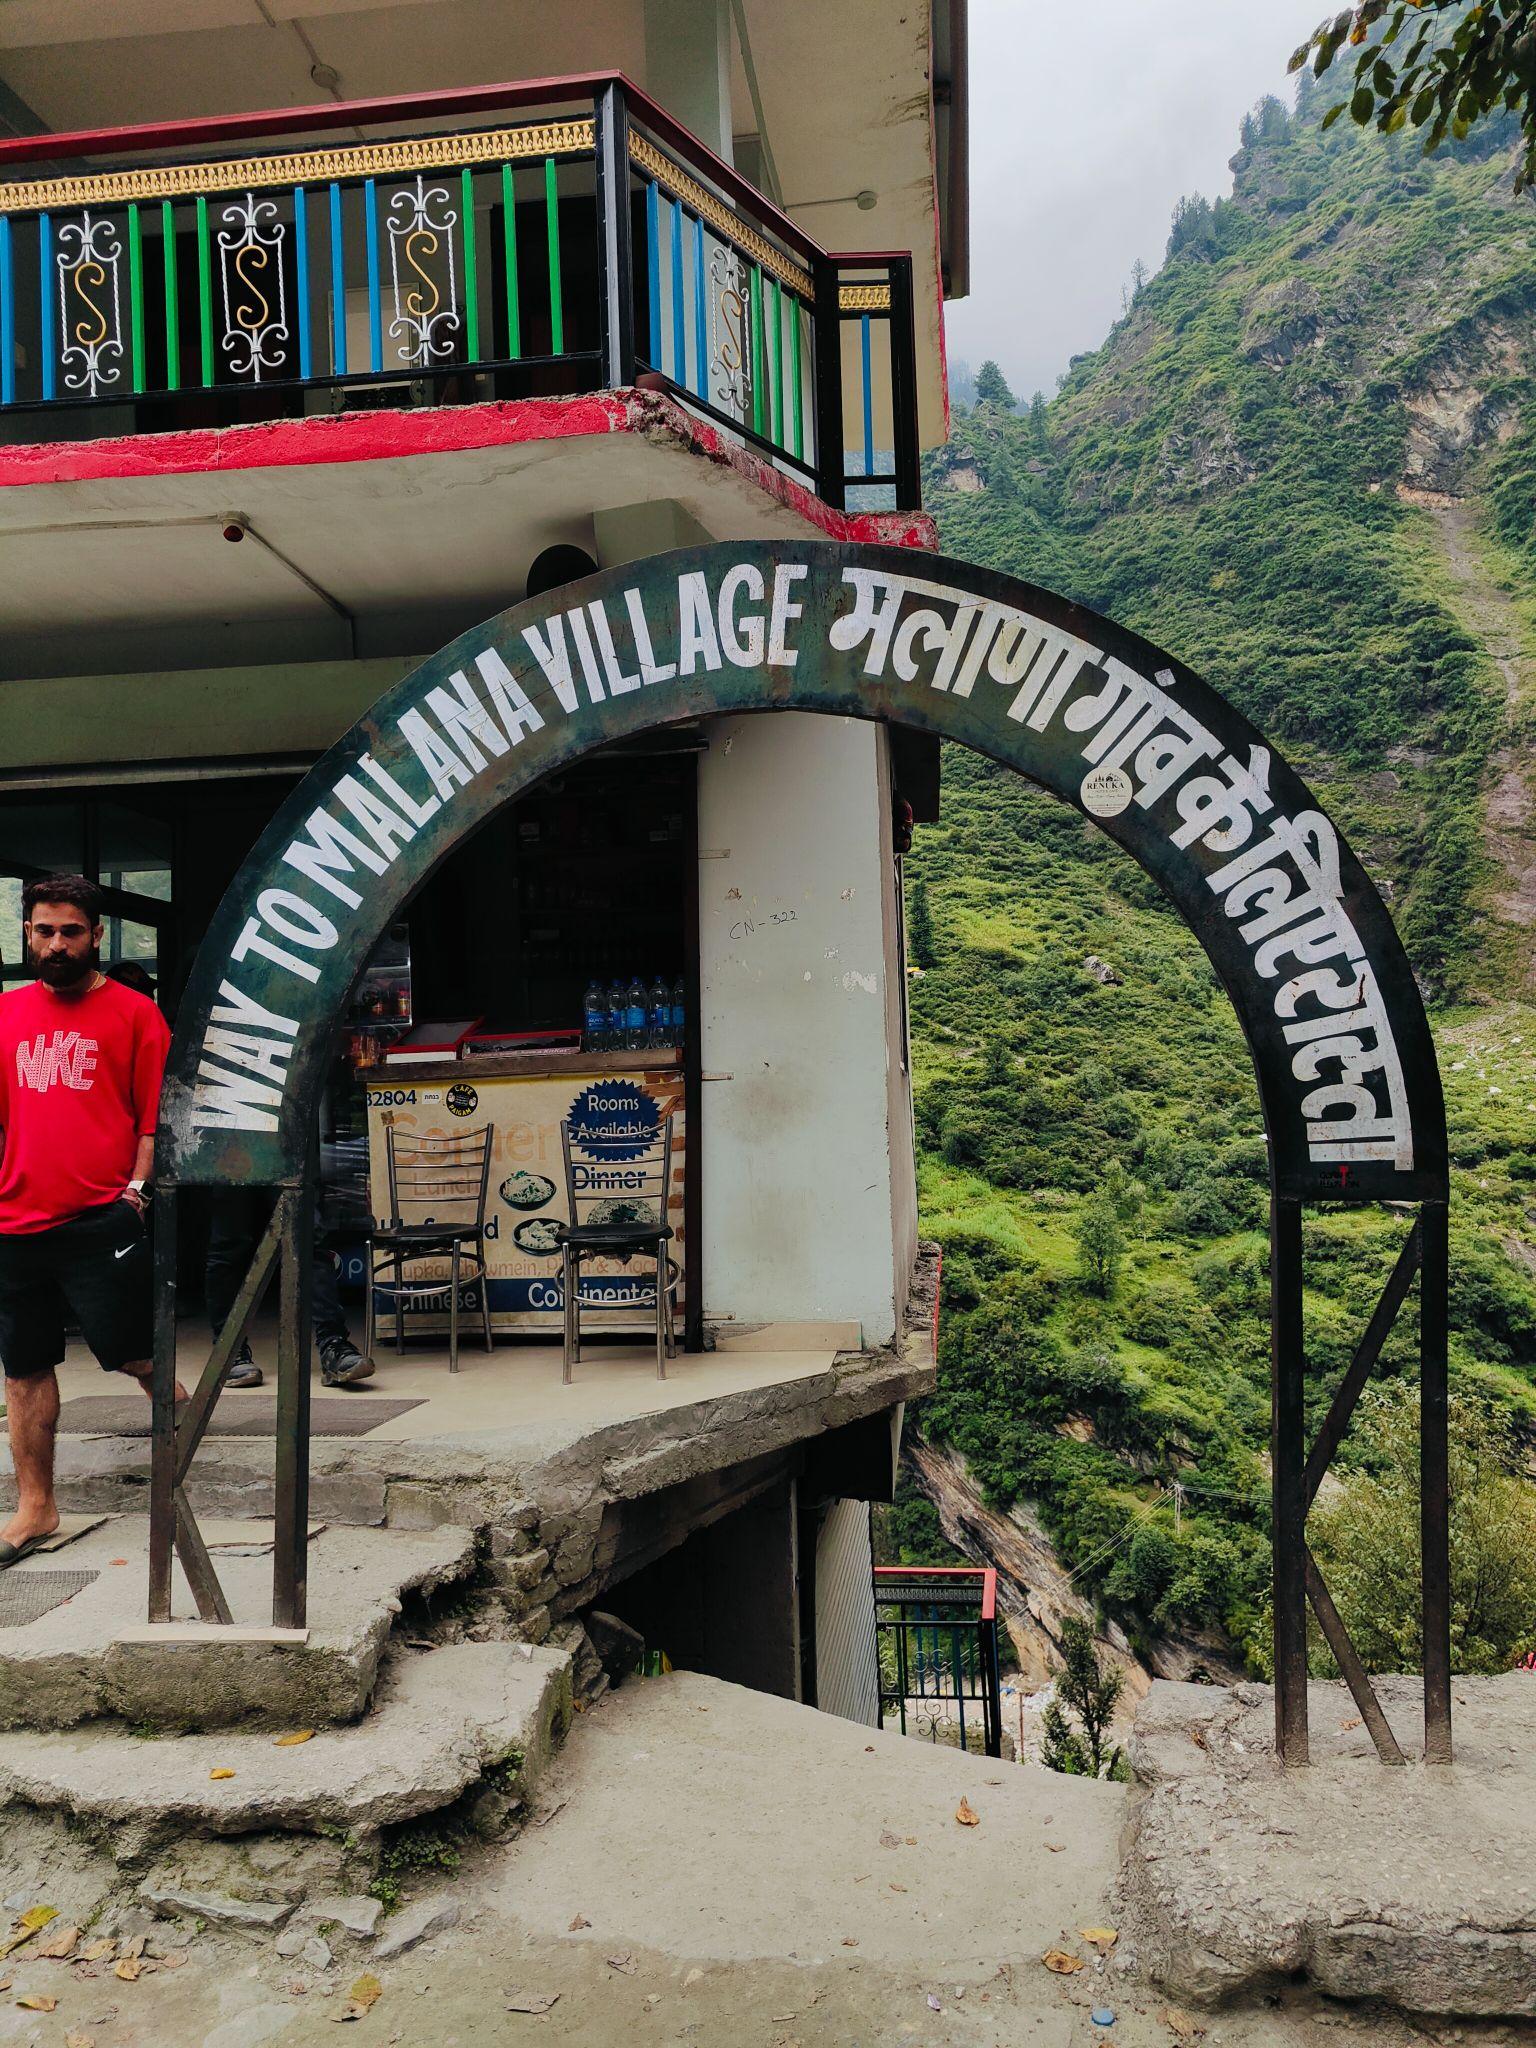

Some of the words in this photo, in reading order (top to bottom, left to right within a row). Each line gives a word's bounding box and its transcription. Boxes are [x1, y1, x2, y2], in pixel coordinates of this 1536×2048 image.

[520, 563, 808, 714] VILLAGE
[281, 646, 546, 911] MALANA
[1086, 781, 1125, 790] RENUKA
[829, 566, 1109, 734] मलाणा
[1169, 743, 1272, 851] के
[1273, 958, 1416, 1172] रास्ता
[229, 888, 341, 984] TO
[16, 1030, 99, 1093] NIKE
[190, 978, 300, 1133] WAY
[448, 1104, 472, 1117] PAIGAM
[454, 1085, 474, 1096] CAFE
[588, 1094, 640, 1112] Rooms
[387, 1112, 557, 1166] Corner
[577, 1121, 652, 1140] Available
[572, 1165, 647, 1190] Dinner
